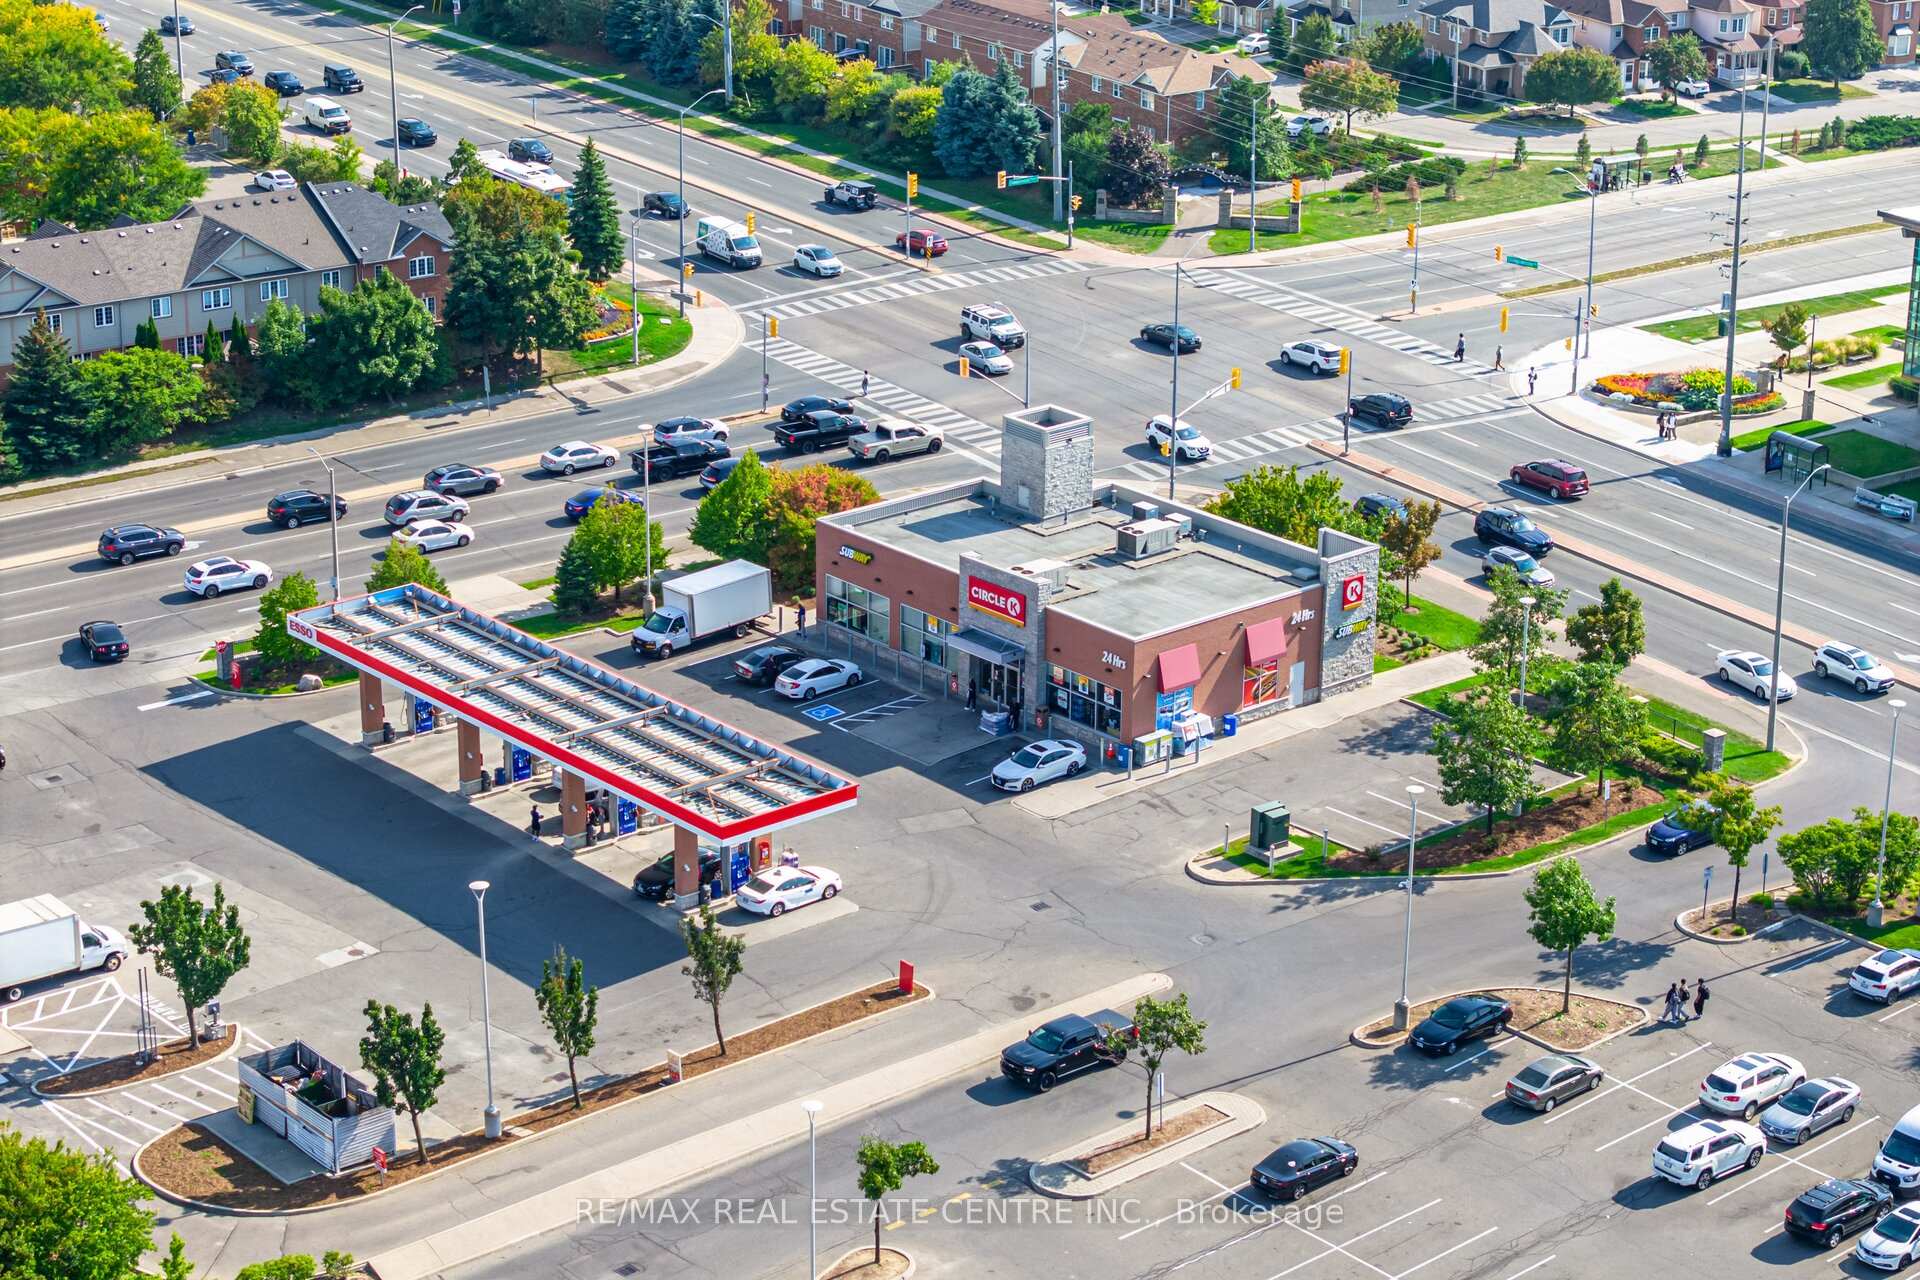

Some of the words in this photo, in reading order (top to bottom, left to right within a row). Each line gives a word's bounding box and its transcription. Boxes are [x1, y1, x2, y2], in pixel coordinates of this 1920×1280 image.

[839, 545, 872, 565] SUBWAY
[971, 586, 1006, 609] CIRCLE
[1007, 597, 1021, 617] K
[1346, 580, 1362, 602] K
[289, 619, 314, 639] ESSO
[1335, 618, 1372, 640] SUBWAY
[1102, 650, 1113, 665] 24
[1112, 653, 1127, 671] Hrs
